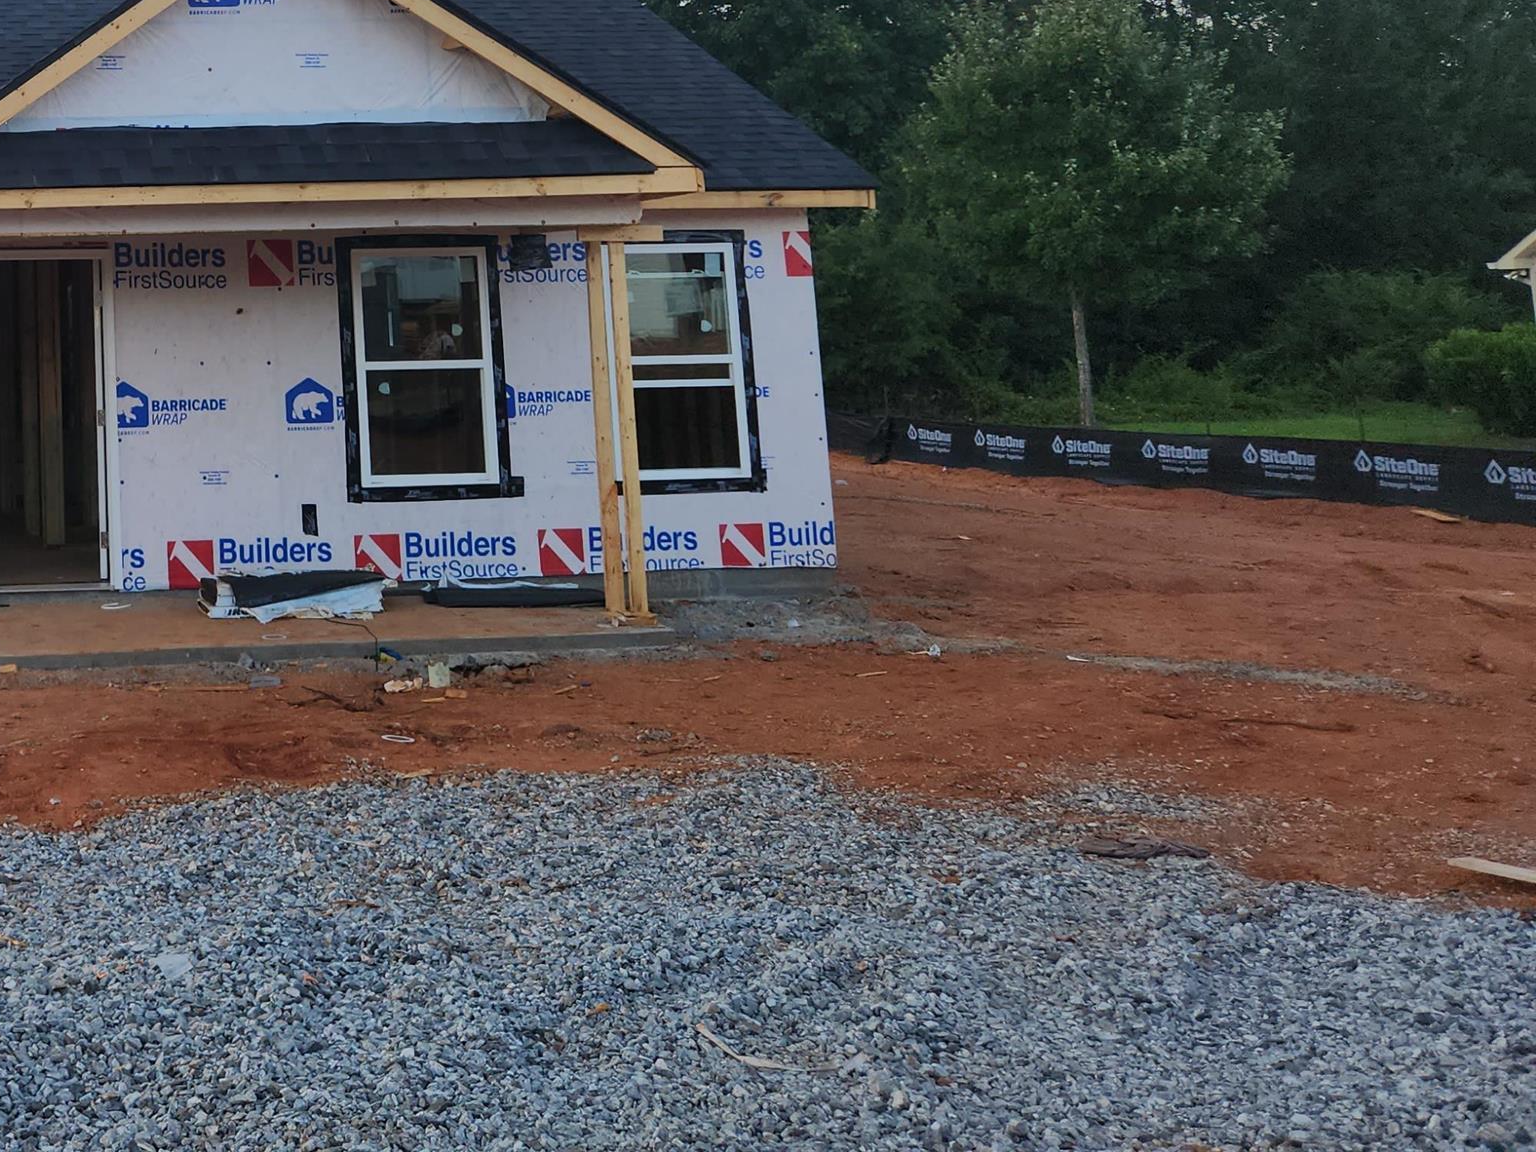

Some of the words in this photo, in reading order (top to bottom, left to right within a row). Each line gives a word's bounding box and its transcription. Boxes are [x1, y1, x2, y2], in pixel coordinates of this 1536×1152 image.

[115, 242, 226, 268] Builders
[114, 270, 227, 289] FirstSource
[518, 389, 592, 403] BARRICADE
[151, 398, 227, 411] BARRICADE
[518, 404, 554, 417] WRAP
[151, 413, 187, 425] WRAP
[918, 428, 952, 442] SiteOne
[986, 433, 1025, 448] SiteOne
[1066, 440, 1111, 454] SiteOne
[1157, 444, 1209, 459] SiteOne
[1260, 449, 1315, 466] SiteOne
[1373, 455, 1439, 476] SiteOne
[219, 537, 332, 564] Builders
[405, 531, 517, 557] Builders
[406, 560, 519, 579] FirstSource
